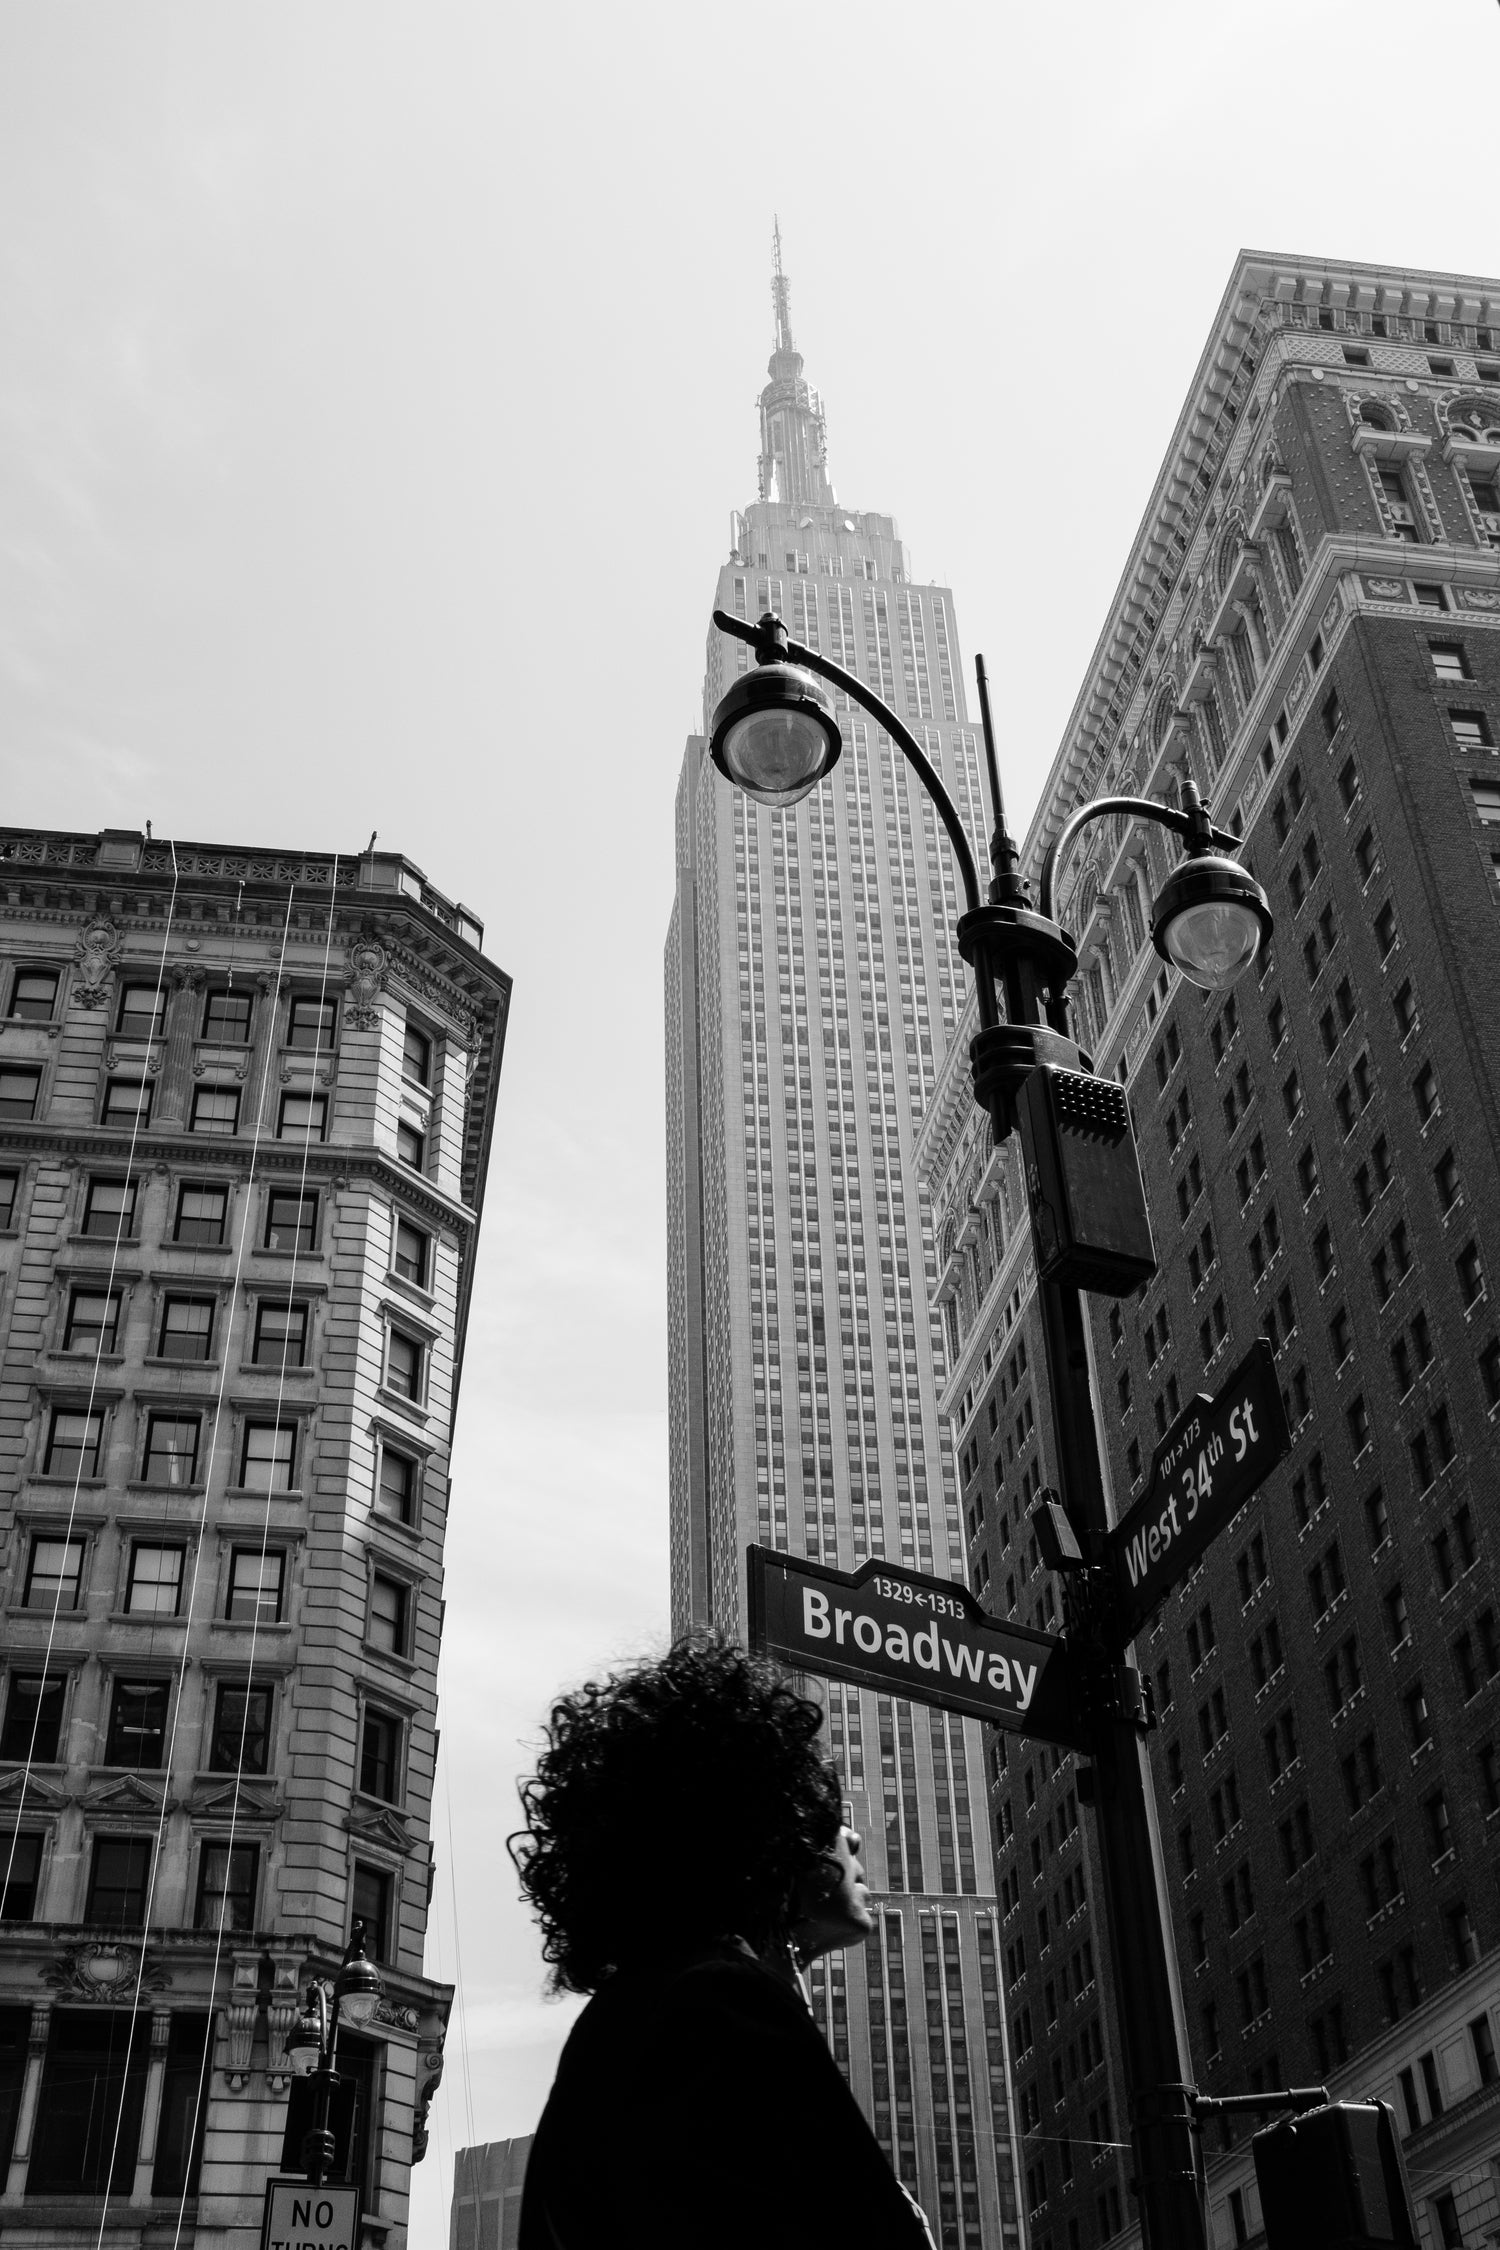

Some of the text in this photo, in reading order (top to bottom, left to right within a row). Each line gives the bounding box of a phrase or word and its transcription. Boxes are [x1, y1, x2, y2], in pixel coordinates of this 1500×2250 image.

[1159, 1417, 1201, 1480] 101 173
[1124, 1397, 1260, 1588] West 34th St
[873, 1576, 966, 1620] 1329 1313
[802, 1586, 1037, 1710] Broadway
[291, 2199, 334, 2229] NO
